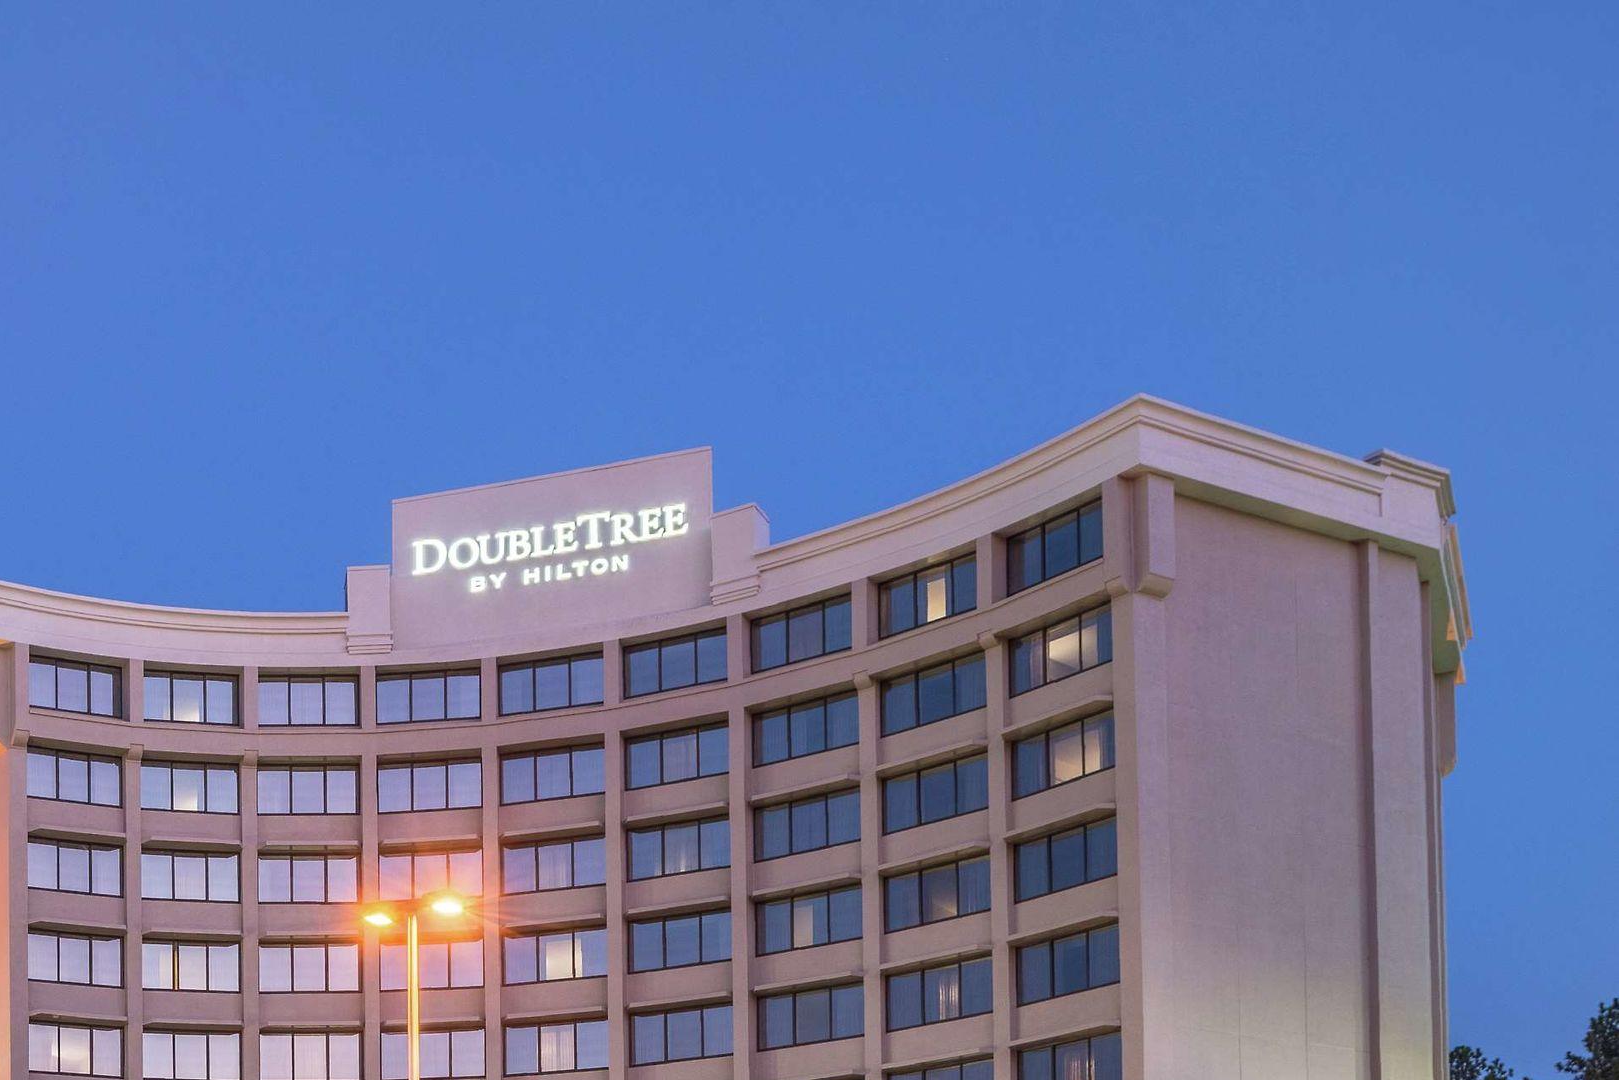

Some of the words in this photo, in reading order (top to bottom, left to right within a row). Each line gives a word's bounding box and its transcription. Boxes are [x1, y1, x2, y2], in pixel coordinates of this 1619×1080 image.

[410, 502, 689, 576] DOUBLETREE
[469, 572, 507, 593] BY
[523, 554, 630, 586] HILTON
